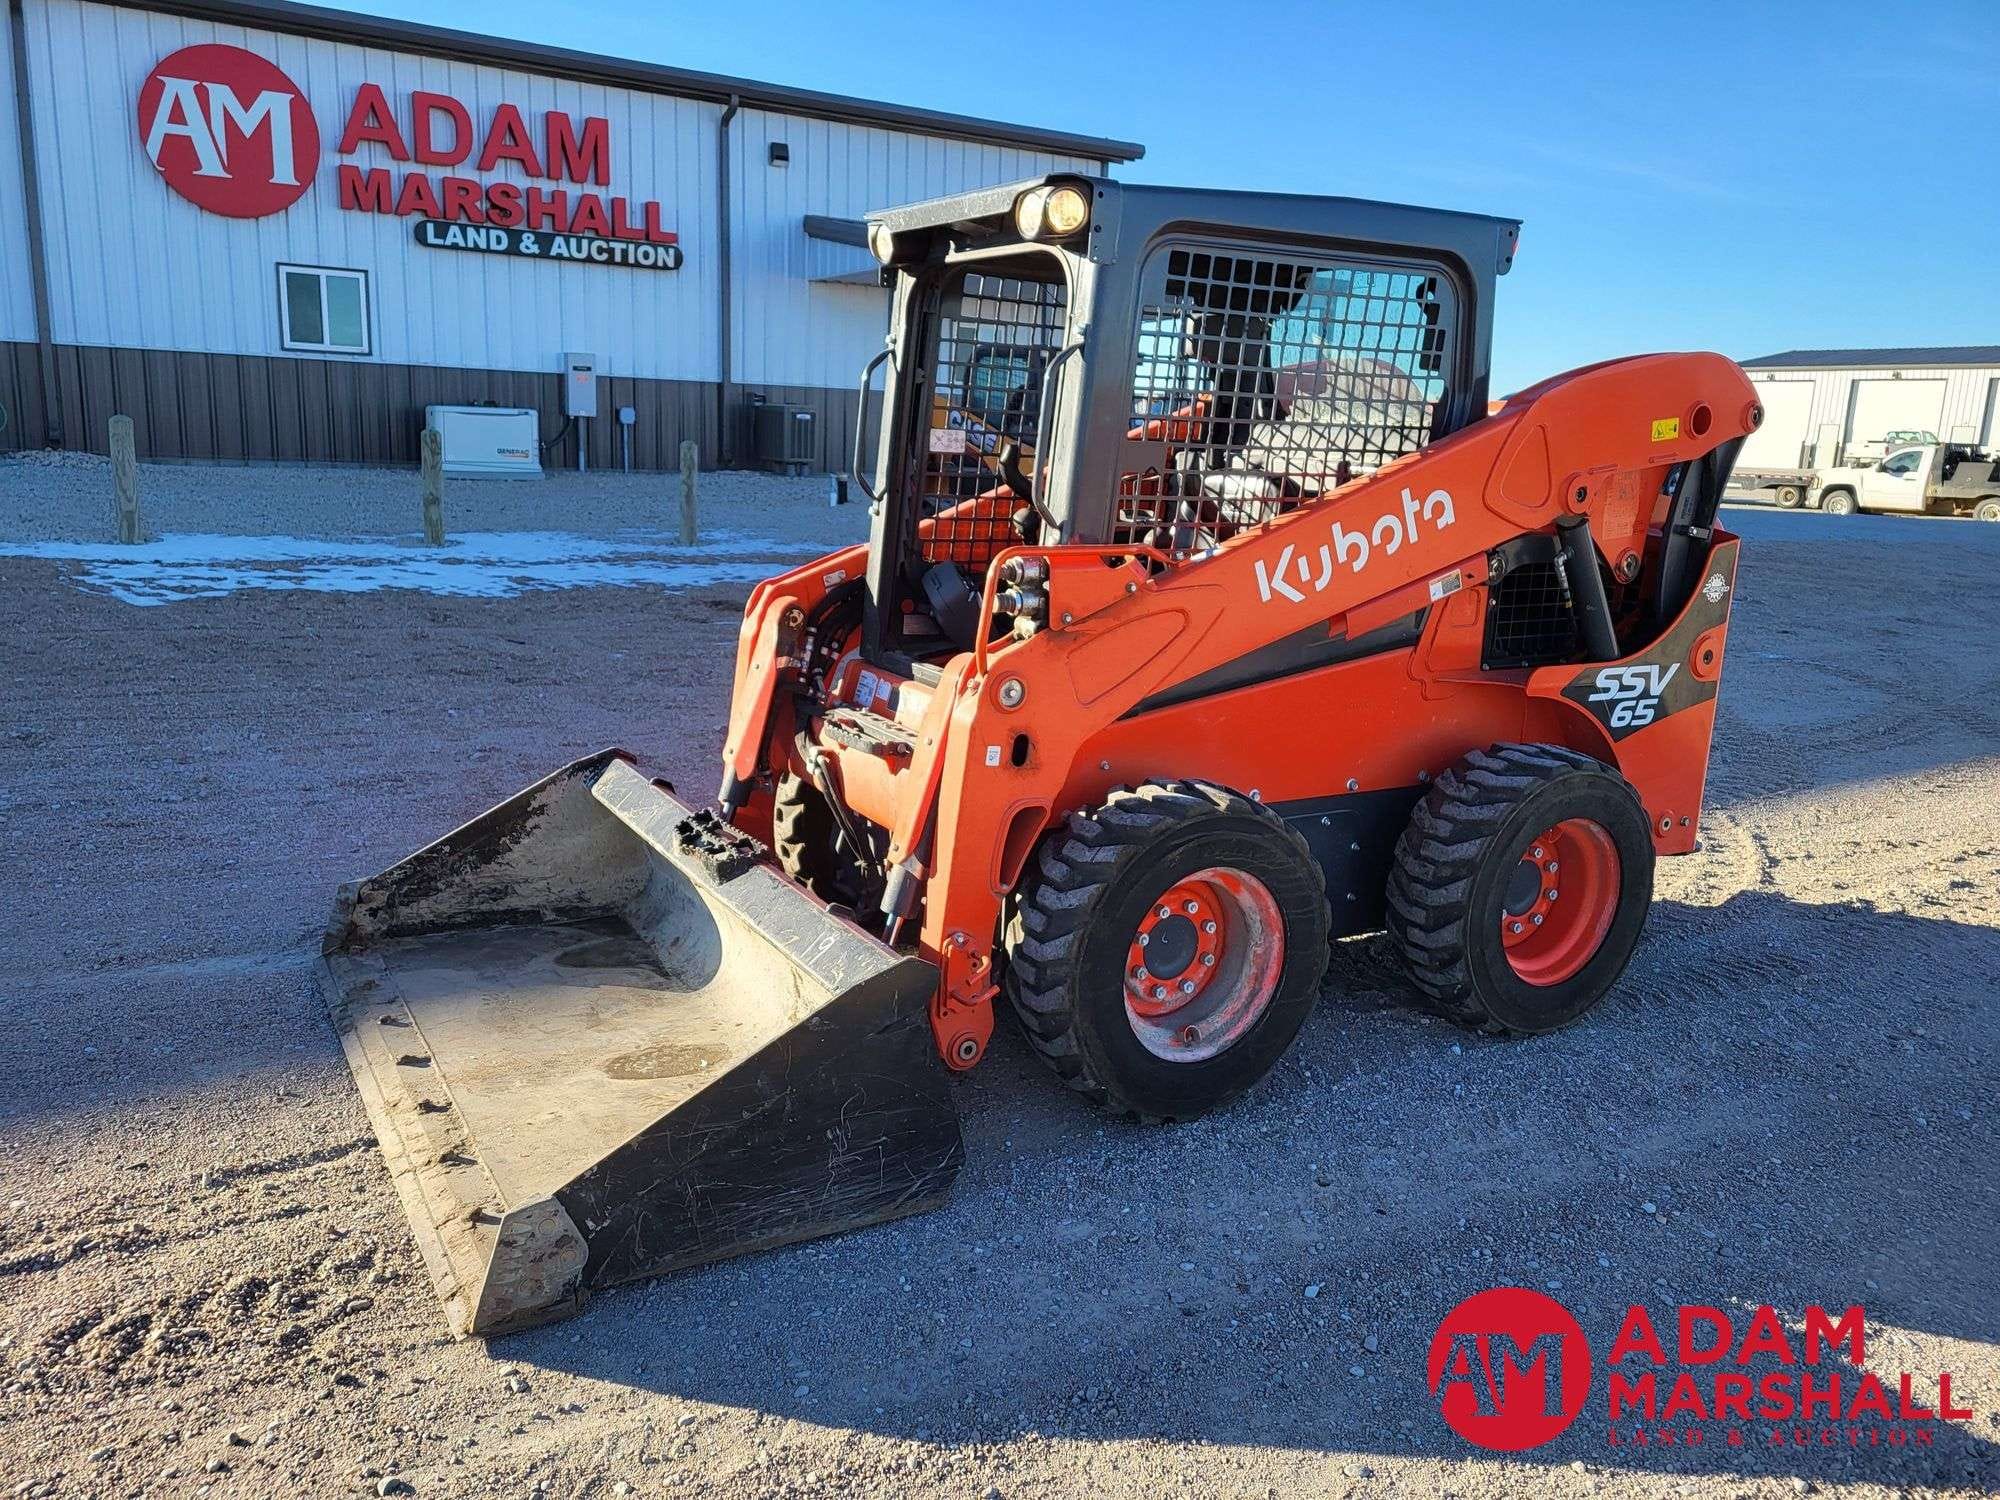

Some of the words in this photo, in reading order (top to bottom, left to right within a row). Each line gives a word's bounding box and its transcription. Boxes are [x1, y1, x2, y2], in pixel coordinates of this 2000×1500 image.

[146, 75, 300, 186] AM
[338, 82, 610, 186] ADAM
[338, 164, 678, 245] MARSHALL
[426, 220, 509, 250] LAND
[519, 232, 541, 255] &
[550, 236, 676, 269] AUCTION
[1254, 488, 1456, 603] Kubota
[1588, 662, 1681, 702] SSV
[1610, 698, 1659, 728] 65
